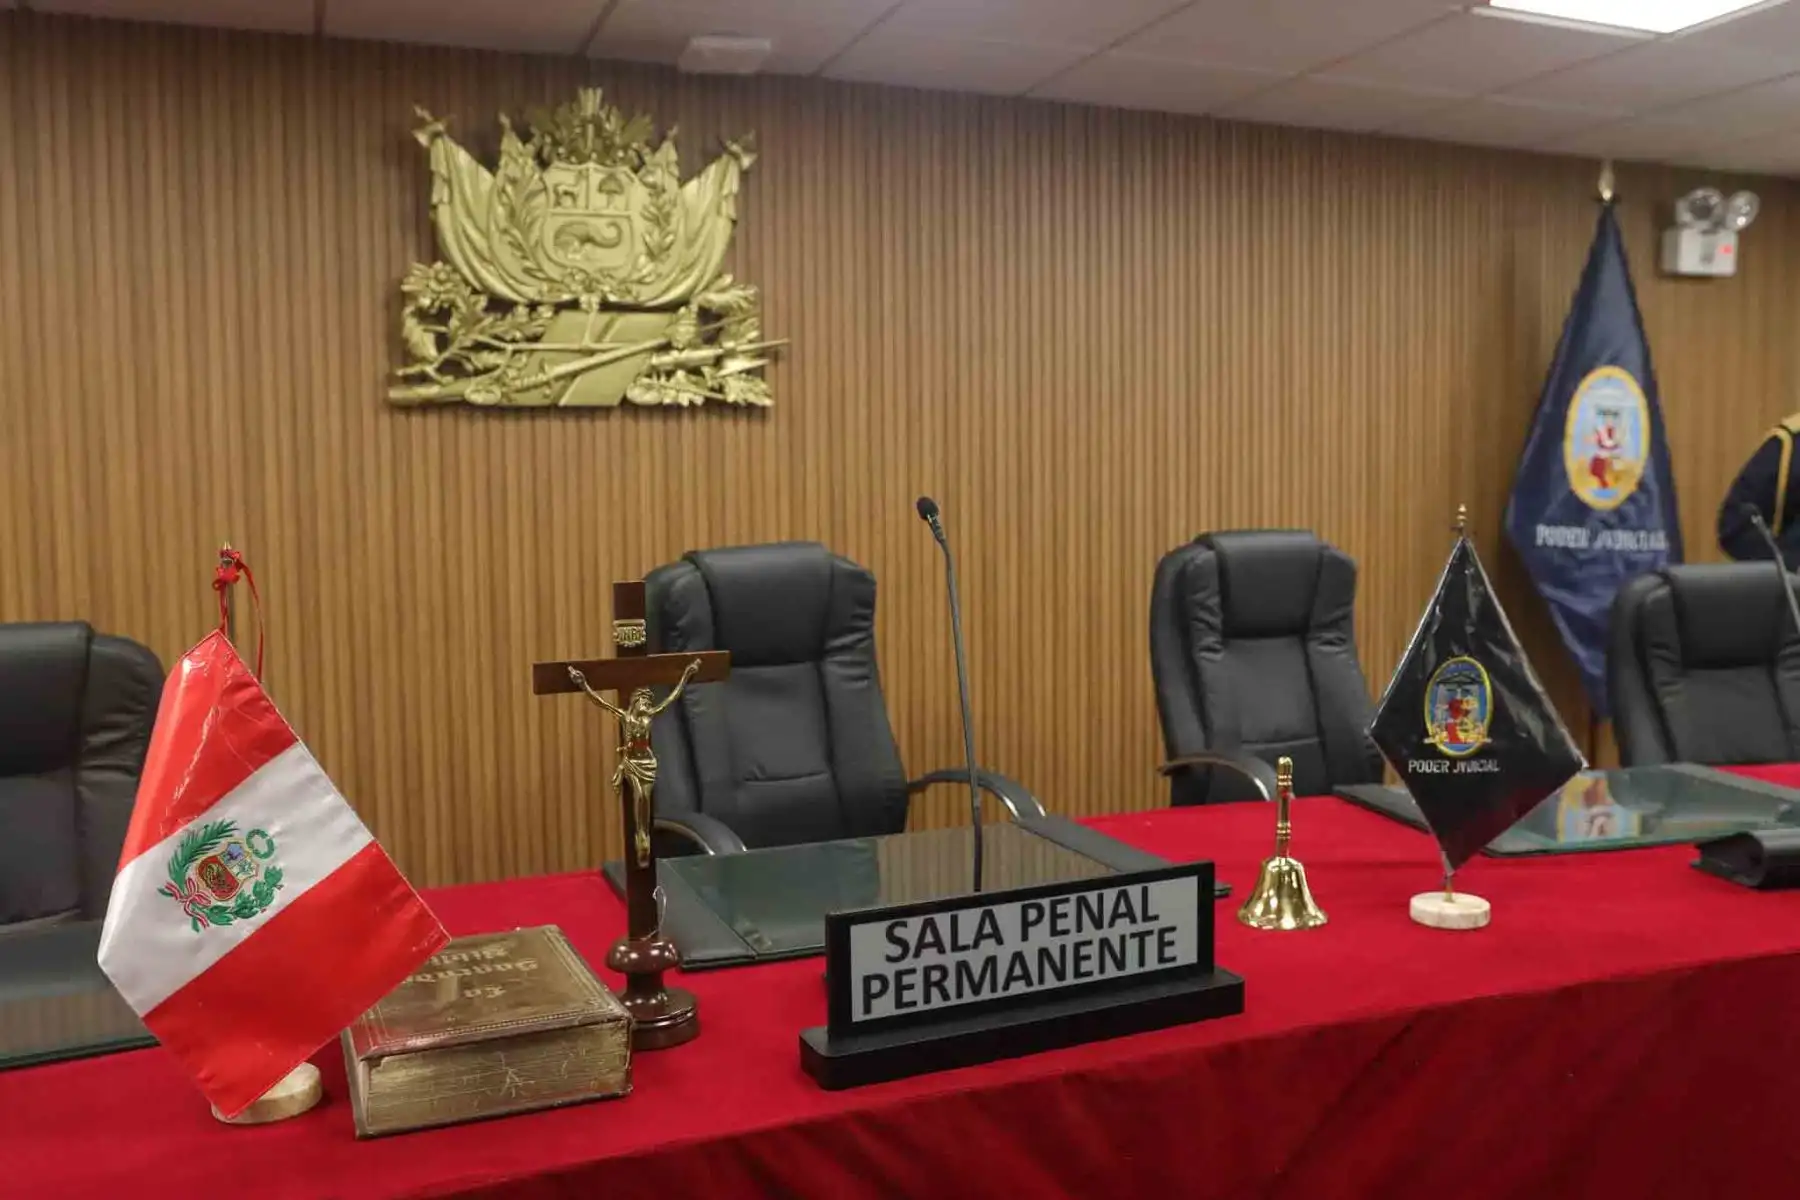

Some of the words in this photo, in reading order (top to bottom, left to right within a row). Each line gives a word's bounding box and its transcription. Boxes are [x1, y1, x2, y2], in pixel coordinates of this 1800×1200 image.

[1408, 759, 1450, 773] PODER
[885, 908, 1004, 963] SALA
[1020, 885, 1159, 942] PENAL
[427, 944, 509, 966] Bibli
[863, 926, 1177, 1015] PERMANENTE
